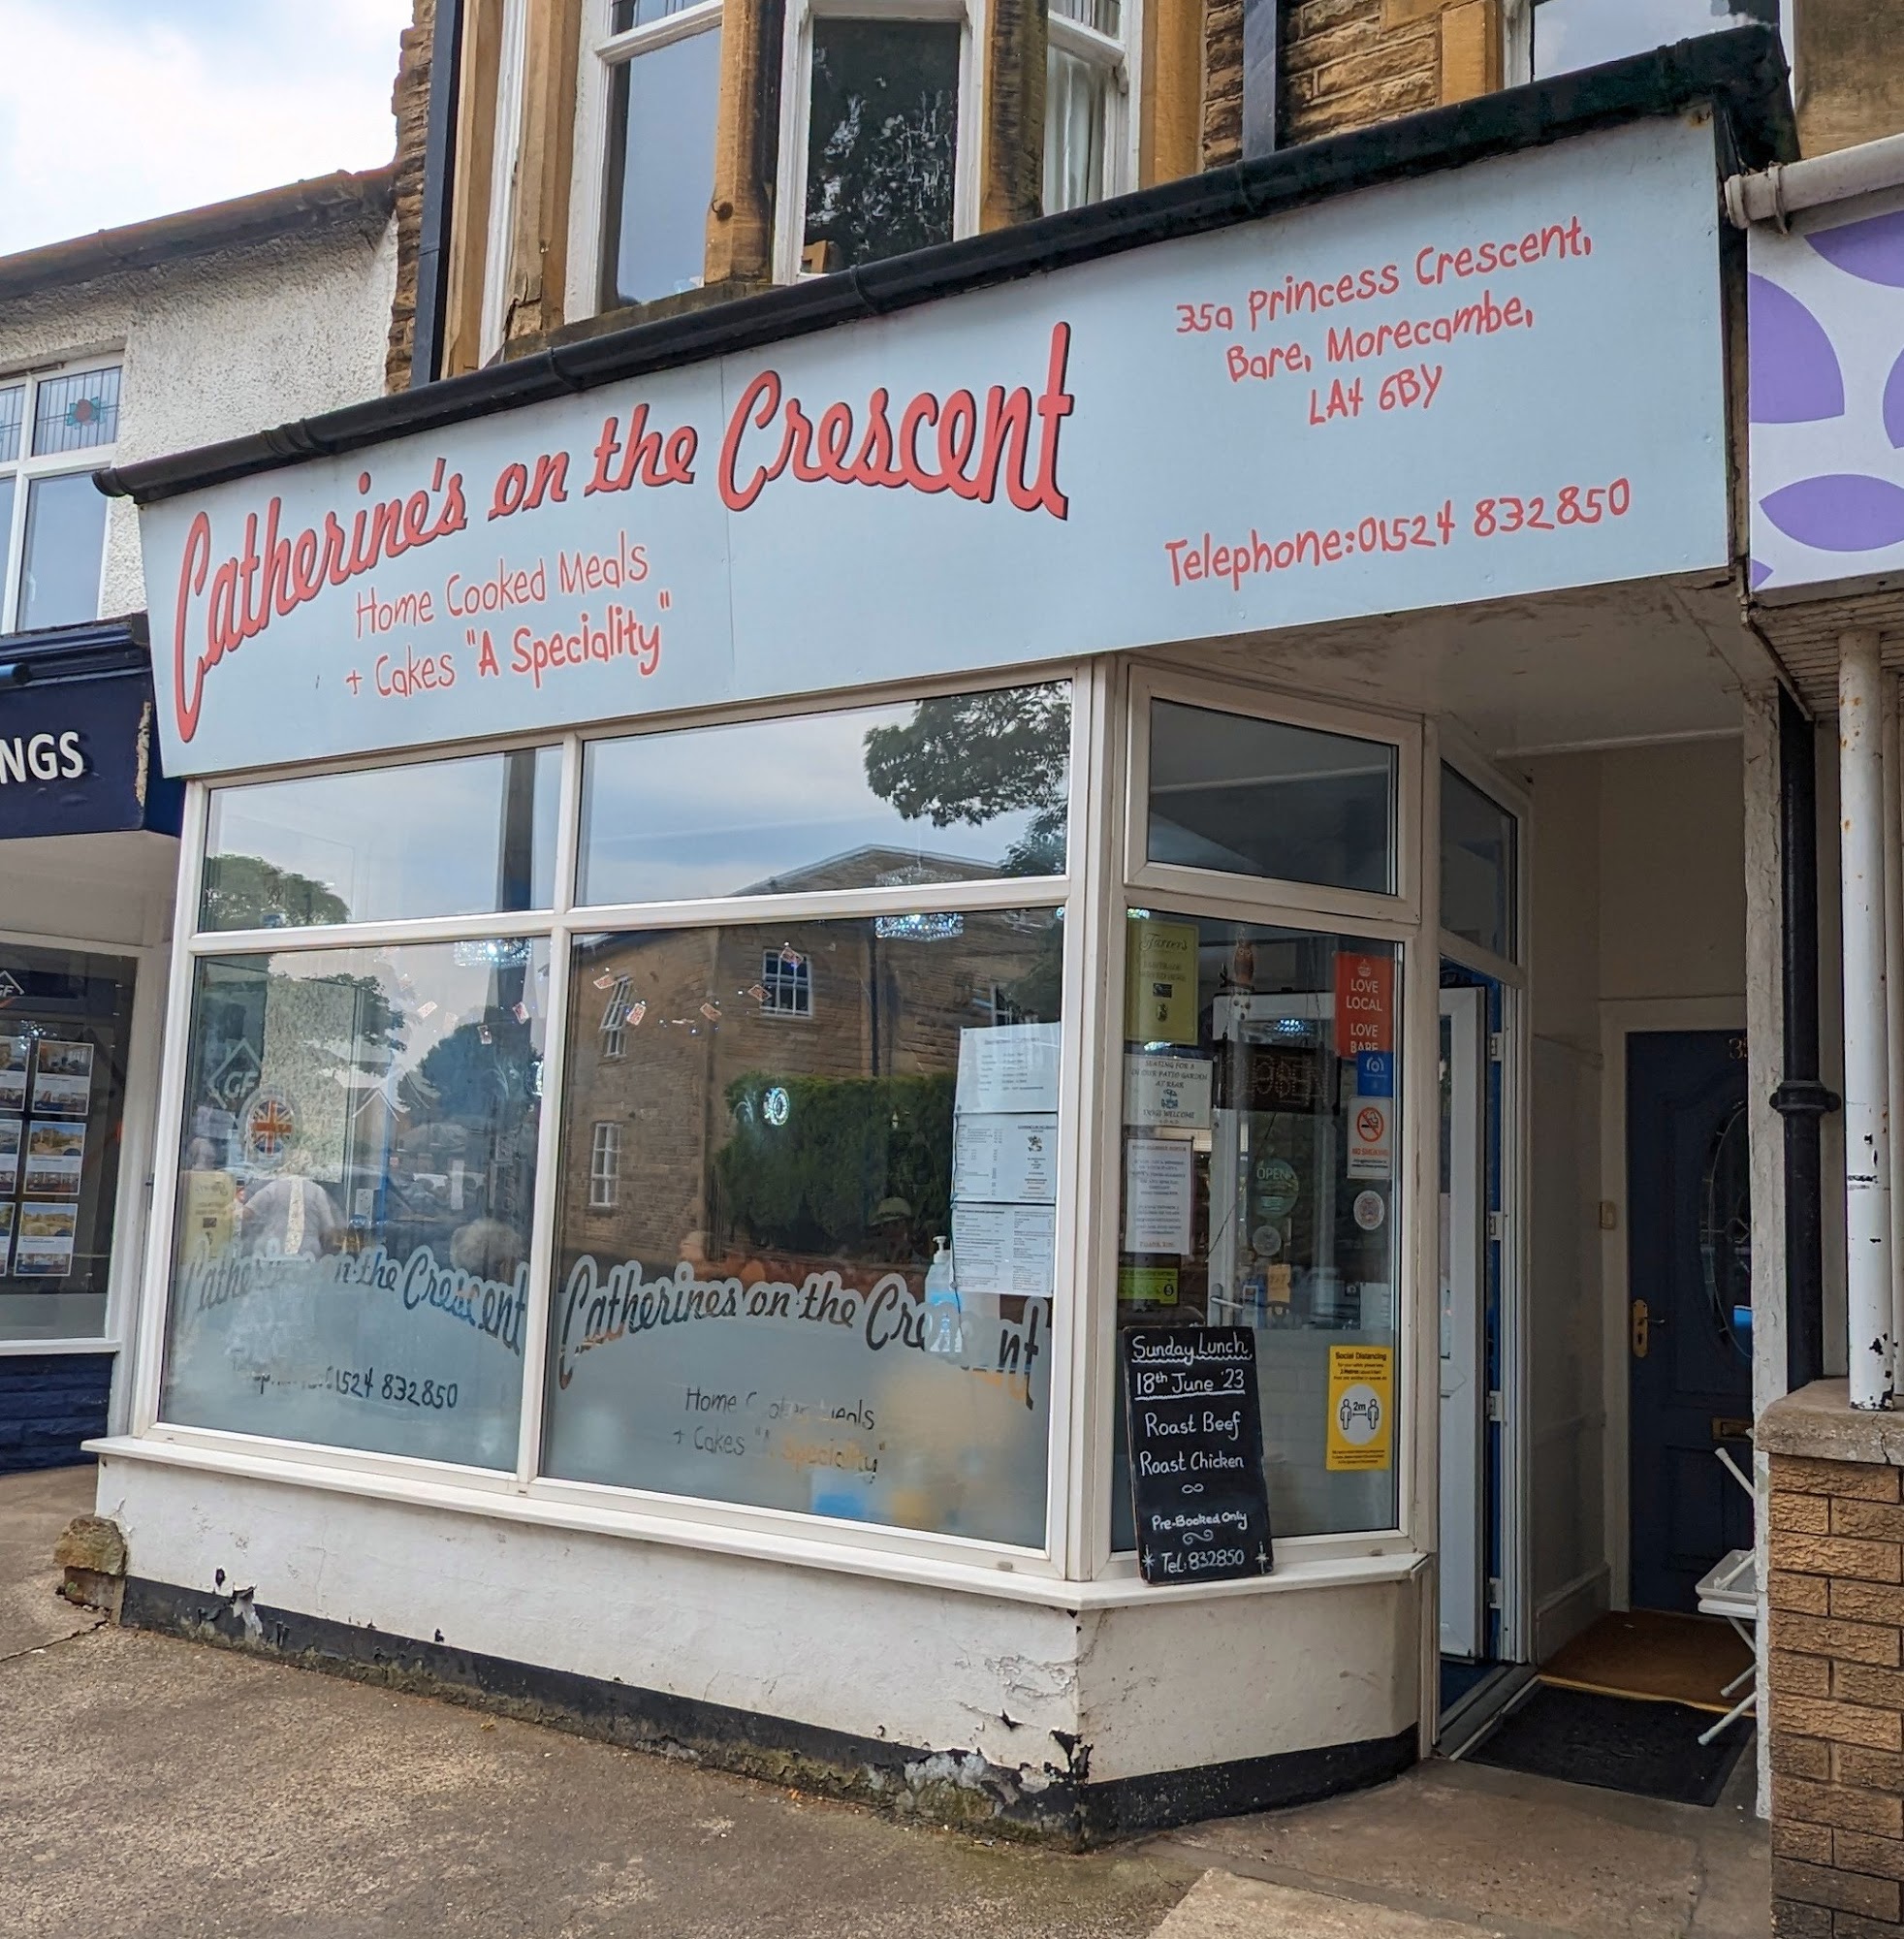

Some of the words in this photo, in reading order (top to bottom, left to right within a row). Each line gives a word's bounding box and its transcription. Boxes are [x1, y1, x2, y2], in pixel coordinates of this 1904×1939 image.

[1175, 302, 1234, 334] 35a
[1309, 376, 1364, 425] LA4
[1378, 364, 1443, 412] 6BY
[1473, 477, 1631, 537] 832850
[174, 457, 468, 743] Catherine's
[487, 452, 570, 522] on
[584, 402, 699, 497] the
[717, 320, 1075, 522] Crescent
[356, 586, 434, 638] Home
[446, 557, 547, 618] Cooked
[559, 530, 649, 596] Meals
[375, 644, 456, 697] Cakes
[0, 731, 84, 784] NGS
[1350, 979, 1379, 994] LOVE
[1346, 995, 1383, 1012] LOCAL
[1350, 1023, 1379, 1037] LOVE
[746, 1288, 790, 1319] on
[798, 1280, 857, 1329] the
[1131, 1335, 1194, 1366] Sunday
[1198, 1331, 1249, 1356] Lunch
[381, 1372, 459, 1410] 832850
[1137, 1371, 1168, 1395] 18th
[1171, 1372, 1215, 1394] June
[685, 1386, 737, 1412] Home
[1352, 1401, 1367, 1412] 2m
[693, 1425, 746, 1456] Cakes
[1145, 1412, 1197, 1438] Roast
[1203, 1411, 1241, 1442] Beef
[1139, 1449, 1187, 1477] Roast
[1190, 1449, 1245, 1471] Chicken
[1151, 1512, 1222, 1531] Pre-Booked
[1222, 1510, 1249, 1531] Only
